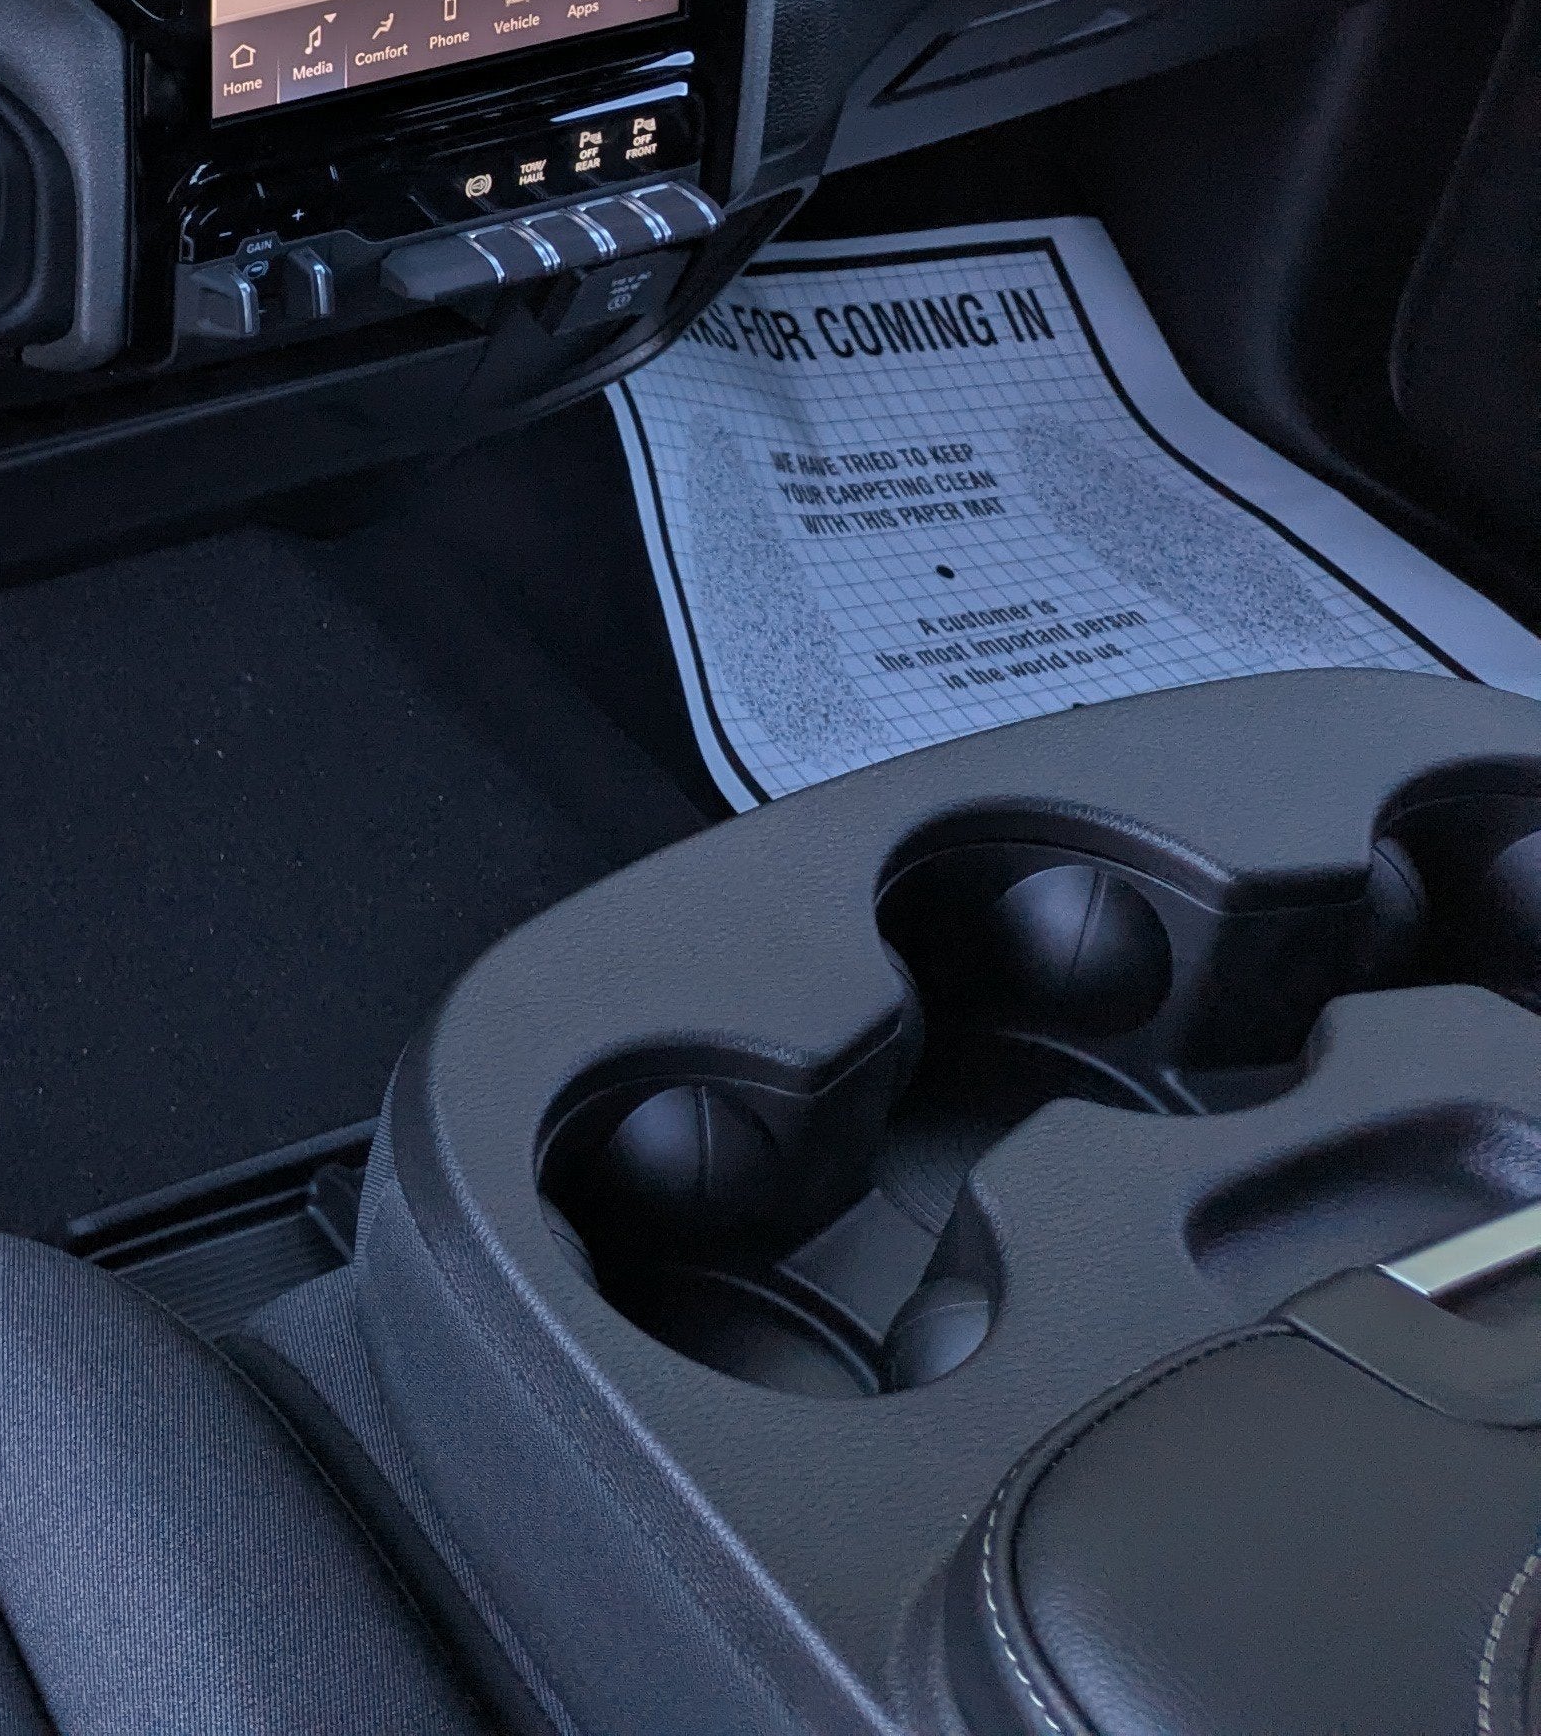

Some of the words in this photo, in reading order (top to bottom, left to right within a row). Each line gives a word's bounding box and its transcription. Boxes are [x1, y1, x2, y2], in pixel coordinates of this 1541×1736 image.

[567, 1, 599, 19] Apps
[494, 14, 540, 34] Vehicle
[429, 29, 470, 50] Phone
[354, 43, 408, 67] Comfort
[292, 59, 333, 81] Media
[222, 75, 263, 96] Home
[633, 133, 653, 146] OFF
[580, 147, 599, 160] OFF
[626, 143, 658, 160] FRONT
[575, 158, 601, 172] REAR
[519, 172, 545, 185] HAUL
[247, 240, 272, 254] GAIN
[732, 304, 817, 362] FOR
[815, 294, 997, 358] COMING
[997, 288, 1055, 343] IN
[770, 450, 797, 473] WE
[797, 453, 840, 477] HAVE
[838, 450, 897, 475] TRIED
[897, 446, 928, 466] TO
[928, 442, 974, 465] KEEP
[778, 481, 827, 506] YOUR
[826, 475, 935, 505] CARPETING
[934, 470, 998, 493] CLEAN
[799, 513, 852, 535] WITH
[848, 509, 898, 531] THIS
[897, 501, 964, 526] PAPER
[962, 496, 1007, 518] MAT
[917, 617, 938, 636] A
[940, 603, 1031, 633] customer
[1030, 598, 1058, 615] is
[875, 651, 915, 673] the
[915, 641, 972, 666] most
[971, 622, 1074, 657] important
[1072, 610, 1148, 640] person
[939, 671, 968, 691] in
[966, 663, 1005, 685] the
[1006, 651, 1069, 678] world
[1066, 646, 1092, 666] to
